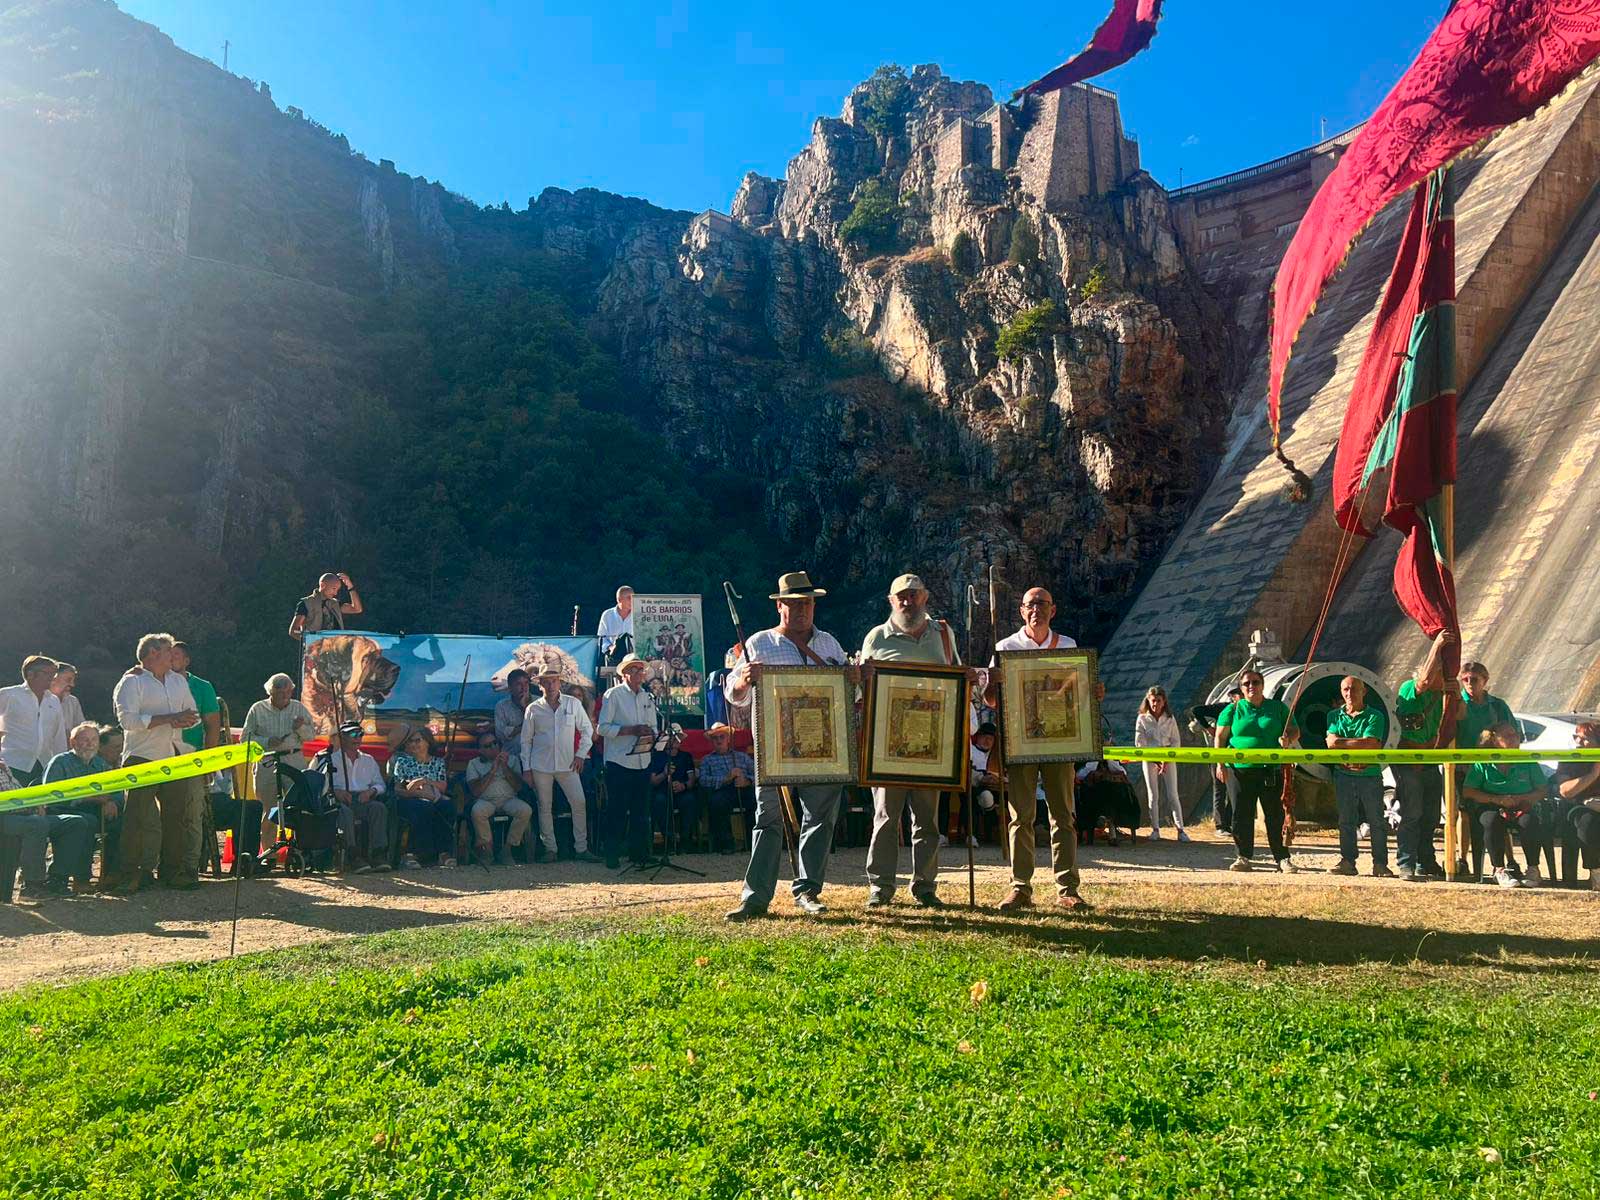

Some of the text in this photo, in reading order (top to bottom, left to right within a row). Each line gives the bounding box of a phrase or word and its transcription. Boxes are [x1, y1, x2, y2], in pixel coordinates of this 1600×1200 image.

[641, 605, 693, 614] LOS BARRIOS
[676, 696, 700, 705] PASTOR
